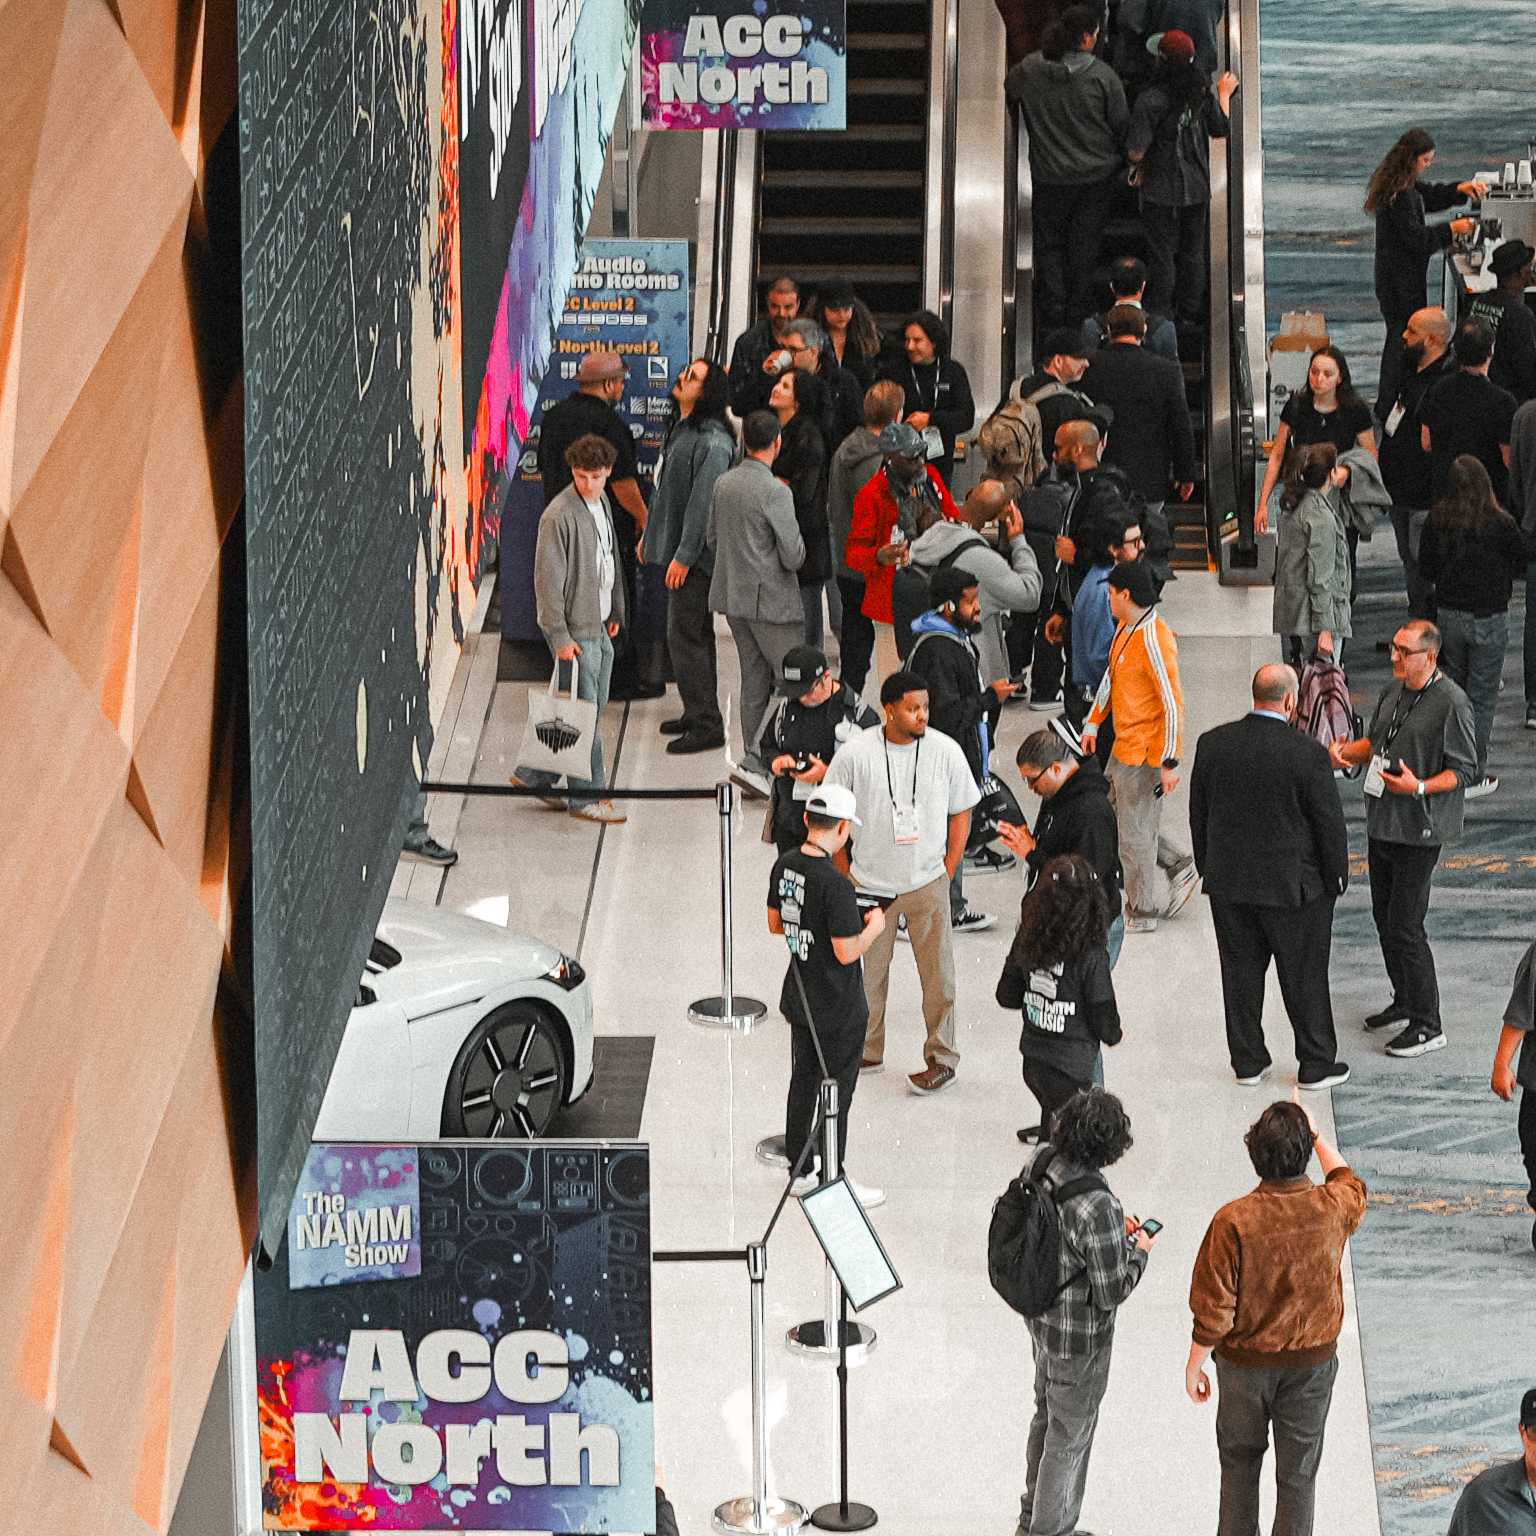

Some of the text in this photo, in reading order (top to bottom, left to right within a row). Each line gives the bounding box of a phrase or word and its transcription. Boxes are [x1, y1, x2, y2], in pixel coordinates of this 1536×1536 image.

[682, 14, 804, 59] ACC
[659, 60, 829, 105] North
[584, 256, 647, 274] Audio
[570, 273, 680, 290] mo Rooms
[583, 297, 622, 311] Level
[624, 297, 636, 312] 2
[559, 340, 606, 354] North
[648, 341, 660, 354] 2
[302, 1190, 346, 1216] The
[296, 1205, 412, 1251] NAMM
[344, 1243, 409, 1269] Show
[339, 1328, 571, 1404] ACC
[293, 1412, 621, 1487] North
